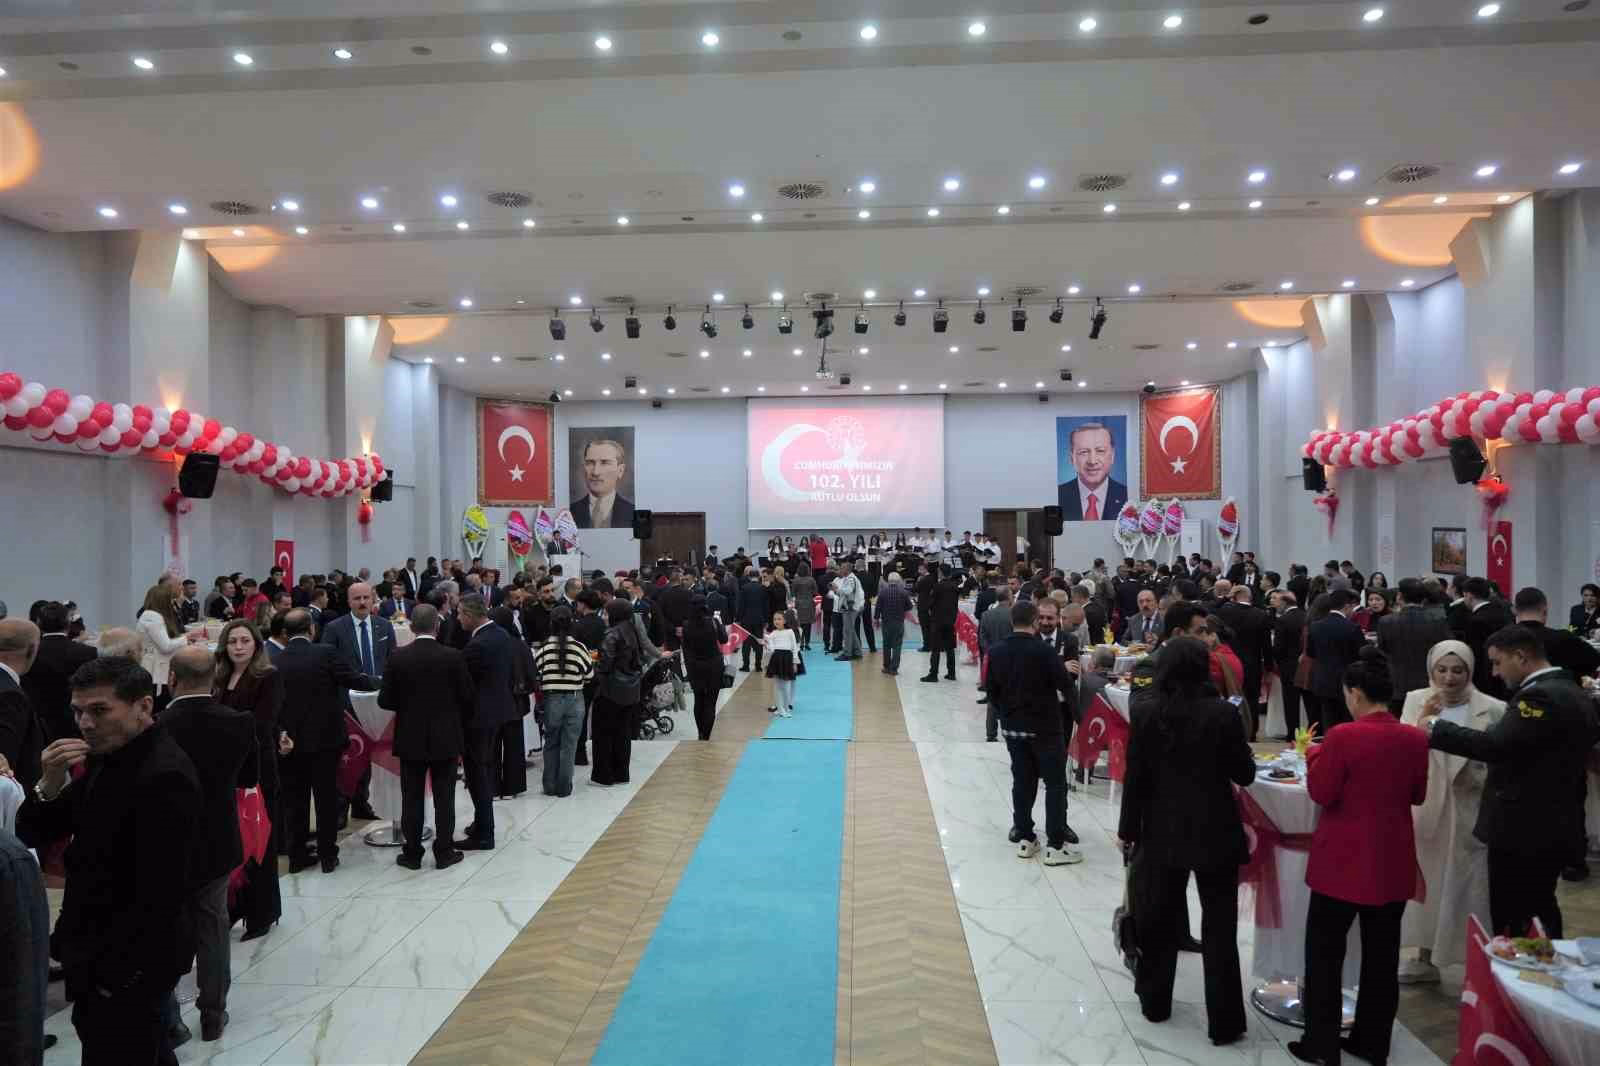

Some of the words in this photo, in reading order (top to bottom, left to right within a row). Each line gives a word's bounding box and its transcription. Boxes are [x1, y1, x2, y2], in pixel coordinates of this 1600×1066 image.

[809, 474, 845, 489] 102.
[849, 474, 881, 489] YILI
[846, 491, 881, 502] OLSUN
